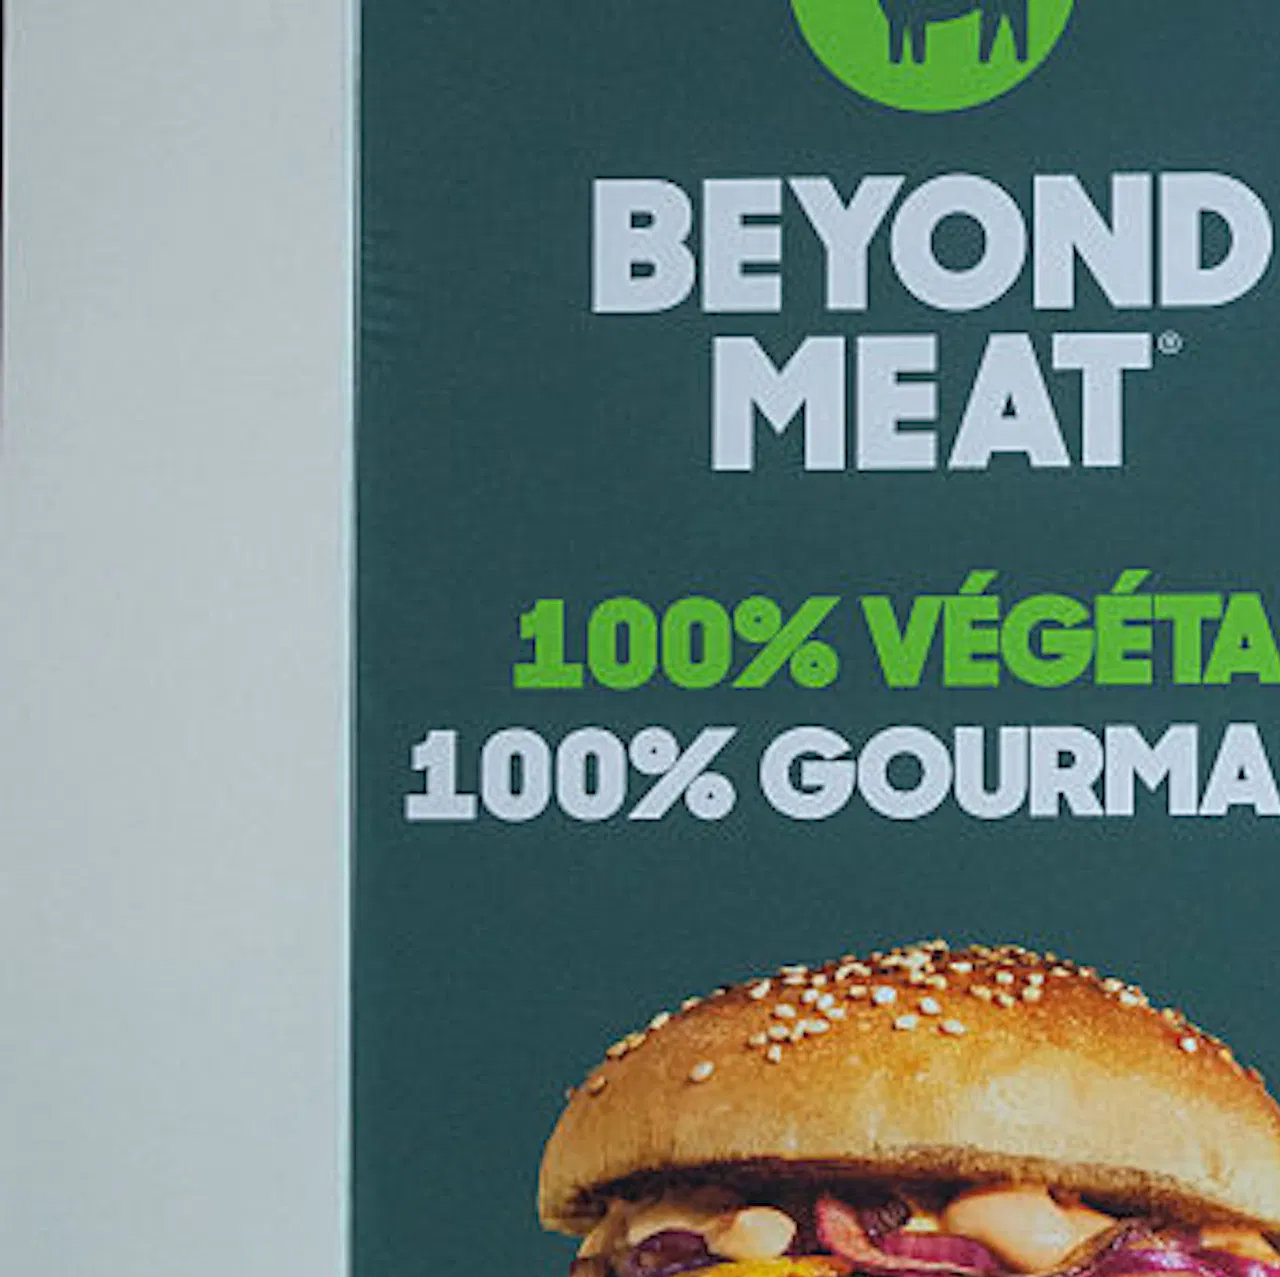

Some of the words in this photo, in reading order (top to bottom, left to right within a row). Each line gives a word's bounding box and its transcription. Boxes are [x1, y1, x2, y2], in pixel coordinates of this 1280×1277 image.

[593, 173, 1273, 313] BEYOND
[514, 596, 840, 690] 100%
[406, 726, 738, 821] 100%
